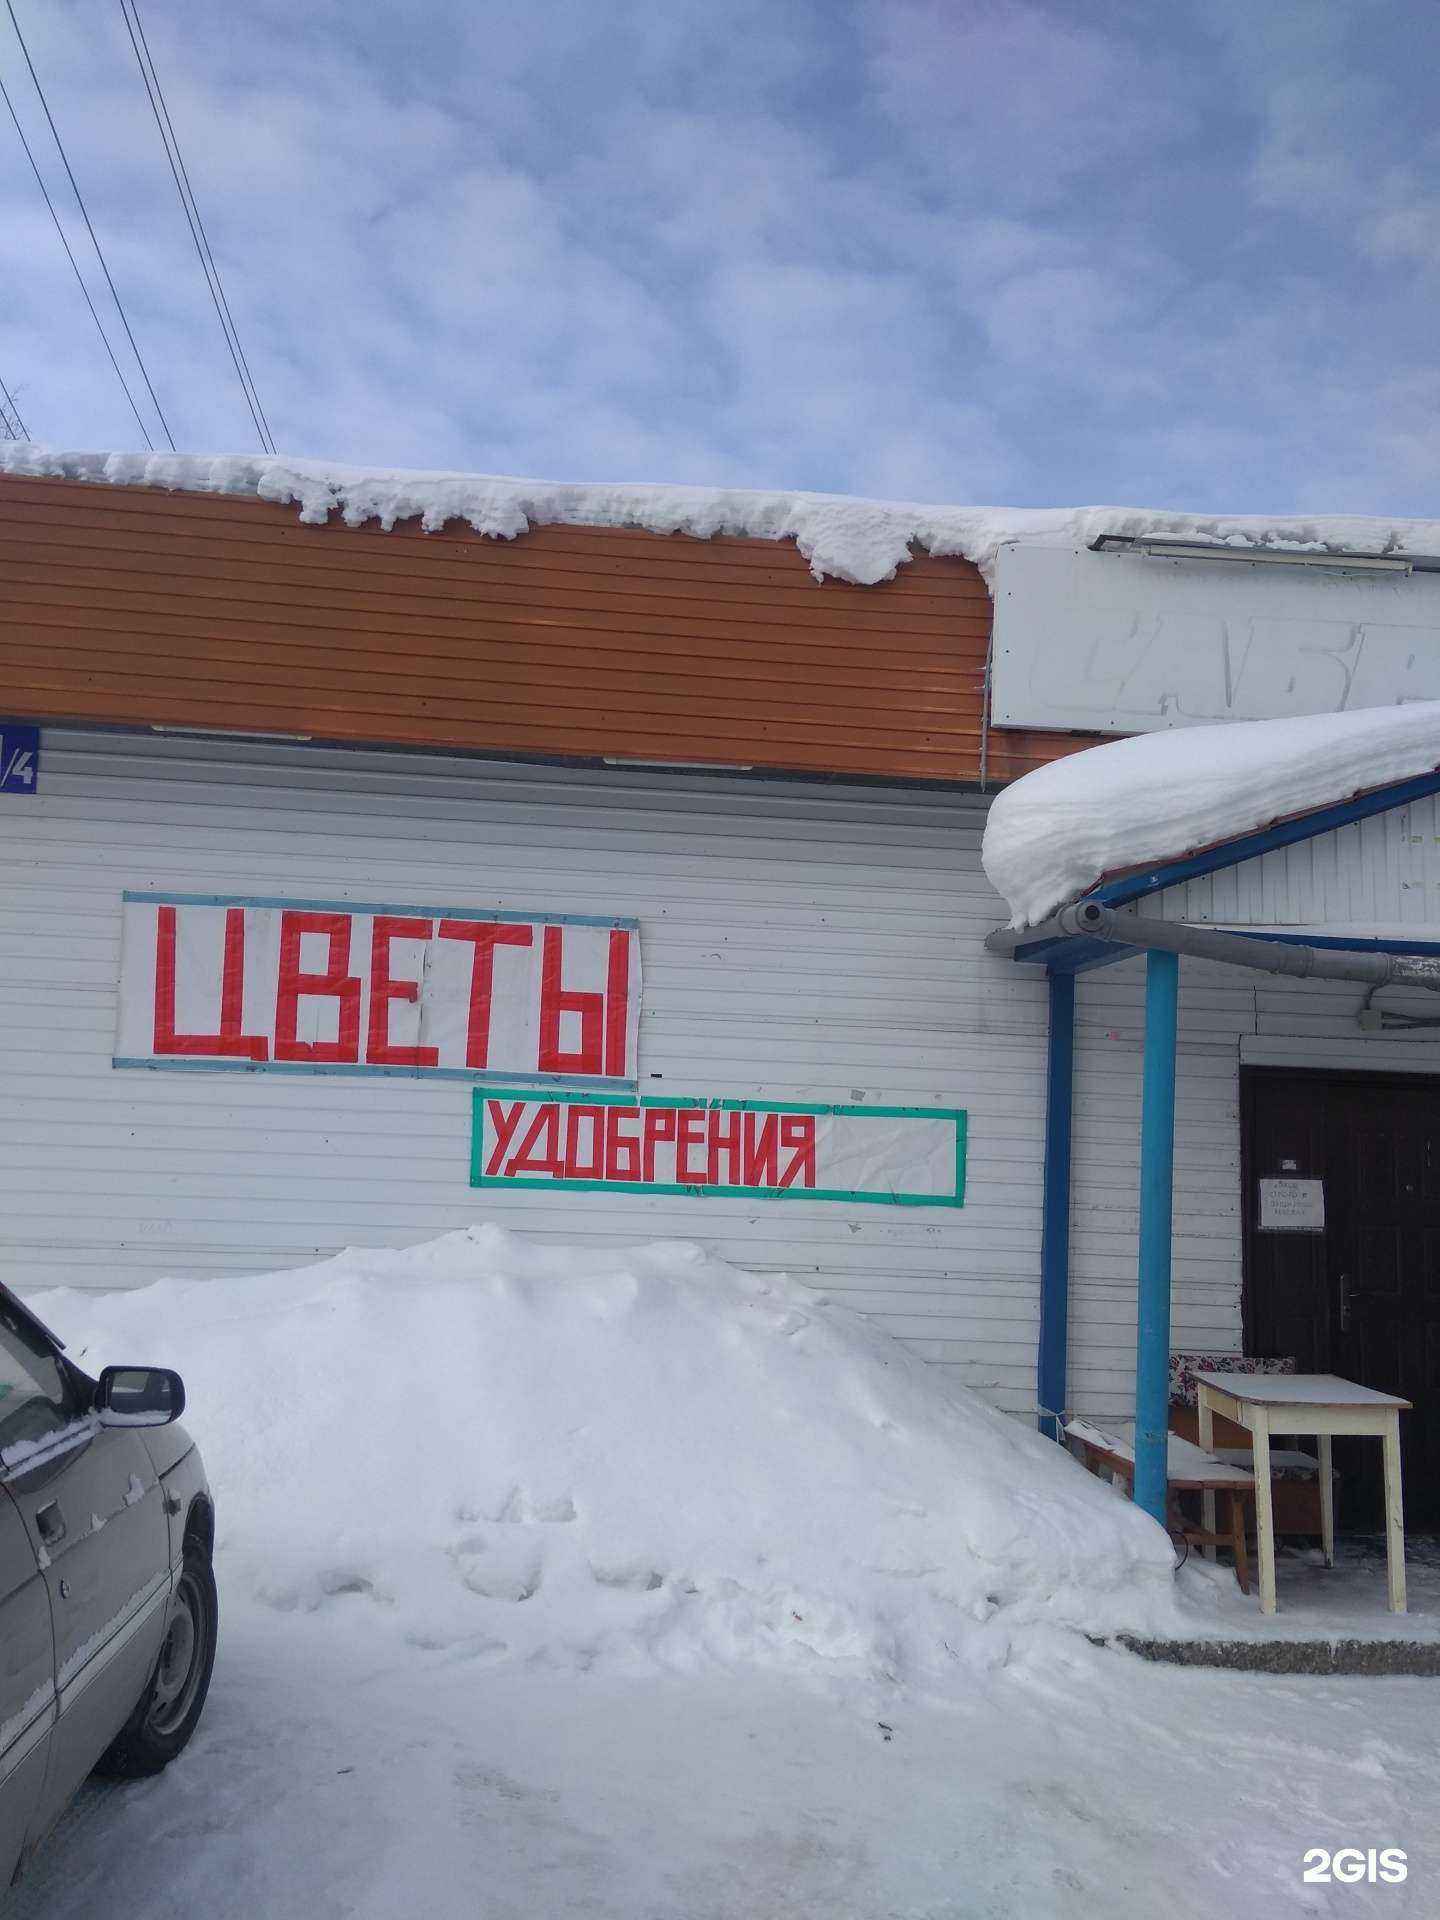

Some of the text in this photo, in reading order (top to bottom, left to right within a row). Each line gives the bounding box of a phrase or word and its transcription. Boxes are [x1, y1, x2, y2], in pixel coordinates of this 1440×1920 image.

[0, 734, 34, 786] /4
[152, 905, 630, 1077] ЦВЕТЫ
[485, 1099, 816, 1188] УДОБРЕНИЯ
